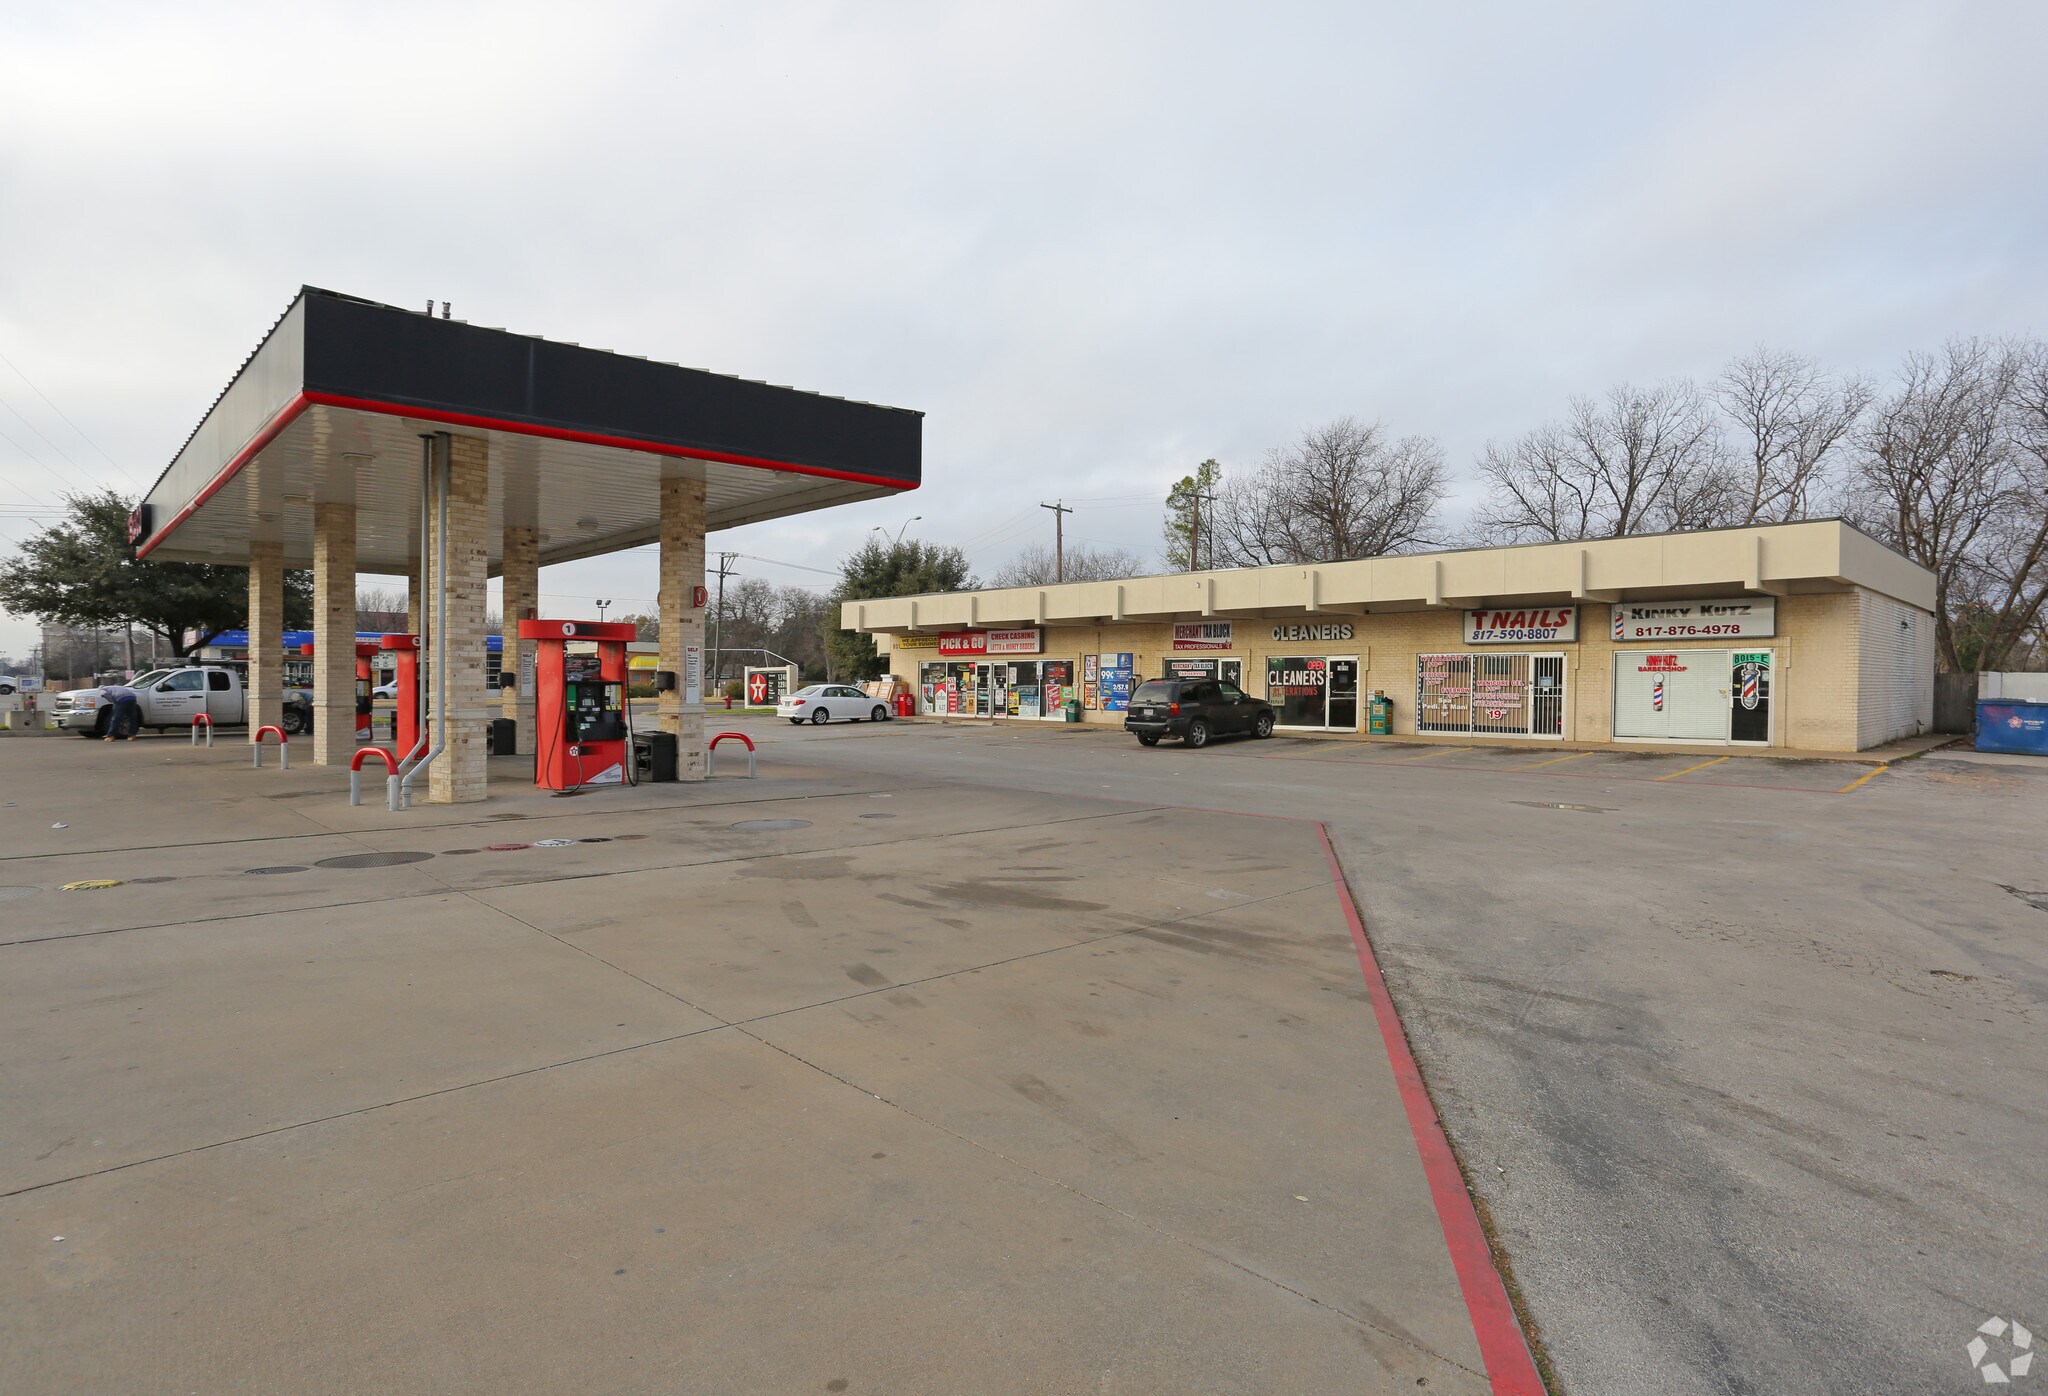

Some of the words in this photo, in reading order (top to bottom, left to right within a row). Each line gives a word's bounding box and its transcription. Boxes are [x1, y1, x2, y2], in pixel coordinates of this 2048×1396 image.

[1631, 608, 1691, 620] KINKY
[1700, 605, 1751, 617] KUTZ
[1471, 612, 1488, 630] T
[1490, 609, 1572, 629] NAILS
[1010, 631, 1035, 639] CASHING
[1175, 625, 1202, 639] MERCHANT
[1203, 624, 1212, 638] TAX
[1213, 623, 1231, 638] BLOCK
[1271, 624, 1352, 641] CLEANERS
[1635, 624, 1740, 637] 817-876-4978
[940, 637, 962, 650] PICK
[963, 639, 970, 649] &
[971, 637, 984, 649] GO
[1019, 642, 1036, 650] ORDERS
[1307, 660, 1325, 670] OPEN
[1663, 654, 1678, 666] KUTZ
[1101, 670, 1114, 680] 99¢
[1268, 670, 1325, 686] CLEANERS
[1272, 686, 1318, 697] ALTERATIONS
